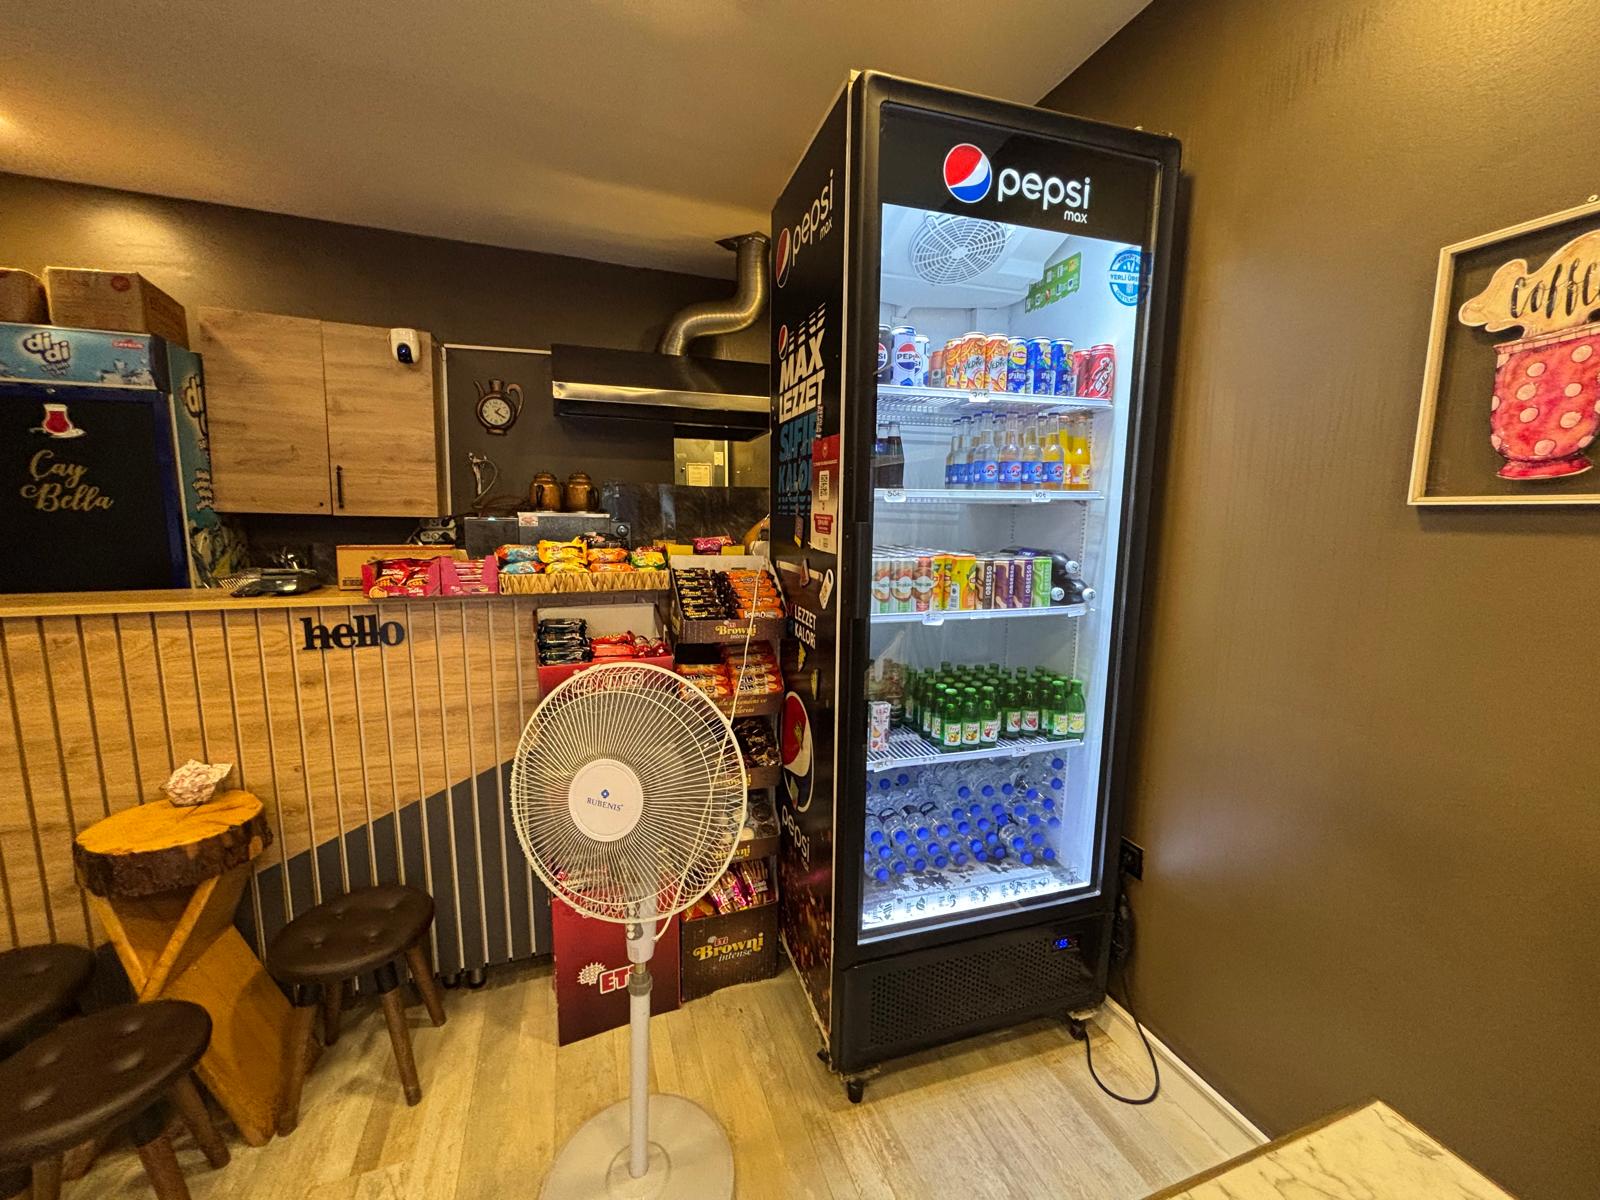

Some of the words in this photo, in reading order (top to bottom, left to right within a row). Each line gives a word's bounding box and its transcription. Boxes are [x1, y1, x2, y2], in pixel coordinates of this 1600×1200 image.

[998, 168, 1091, 211] pepsi
[792, 168, 834, 268] pepsi
[819, 217, 833, 240] max
[1064, 210, 1088, 224] max
[1510, 258, 1600, 319] Coffe
[24, 331, 51, 354] di
[41, 341, 71, 364] di
[778, 324, 826, 394] MAX
[778, 368, 826, 425] LEZZET
[778, 459, 813, 495] KALO
[19, 483, 115, 513] Bella
[985, 564, 993, 595] OBSESSO
[299, 613, 406, 651] hello
[714, 624, 758, 637] Browni
[794, 604, 817, 630] LEZZET
[781, 804, 811, 863] pepsi
[692, 932, 764, 961] Browni
[718, 948, 753, 962] intense
